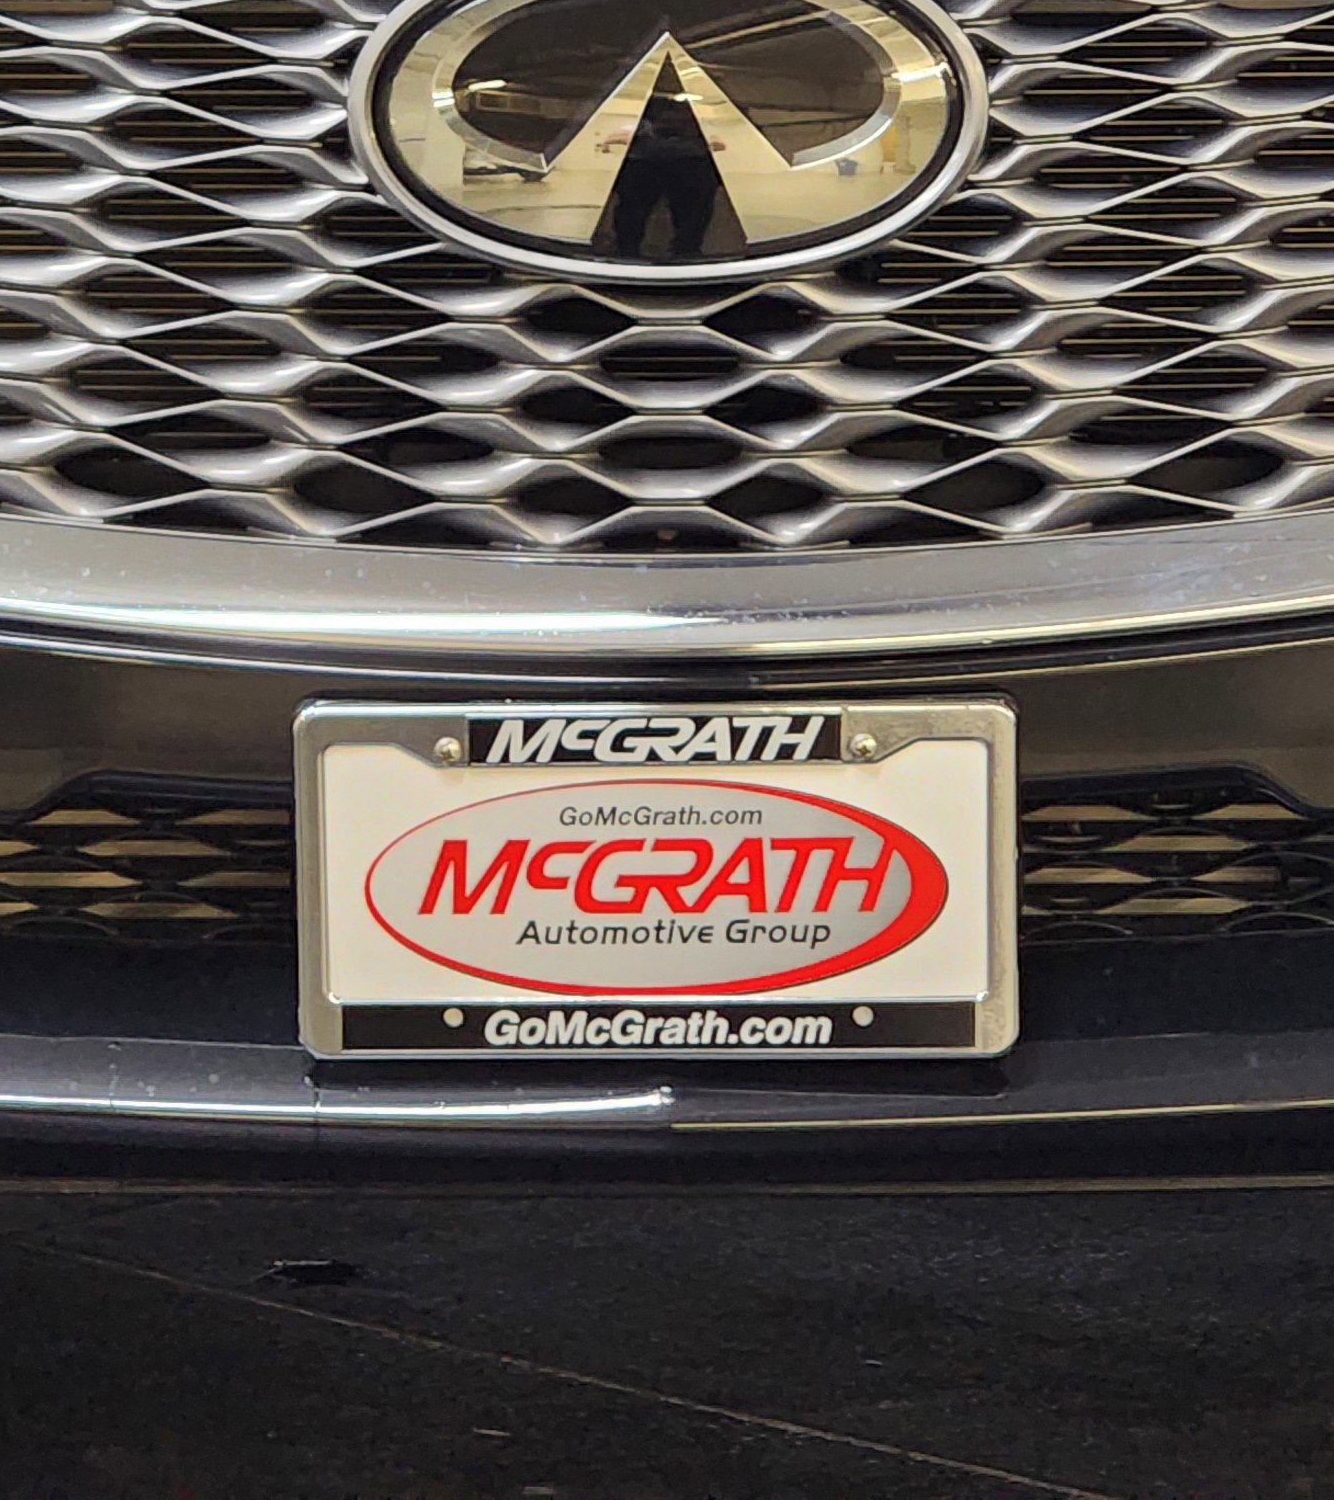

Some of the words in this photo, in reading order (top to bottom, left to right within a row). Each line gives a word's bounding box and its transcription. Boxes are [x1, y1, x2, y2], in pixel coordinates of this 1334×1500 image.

[558, 806, 763, 827] GoMcGrath.com
[515, 920, 714, 946] Automotive
[725, 919, 832, 950] Group
[483, 1009, 833, 1046] GoMcGrath.com
